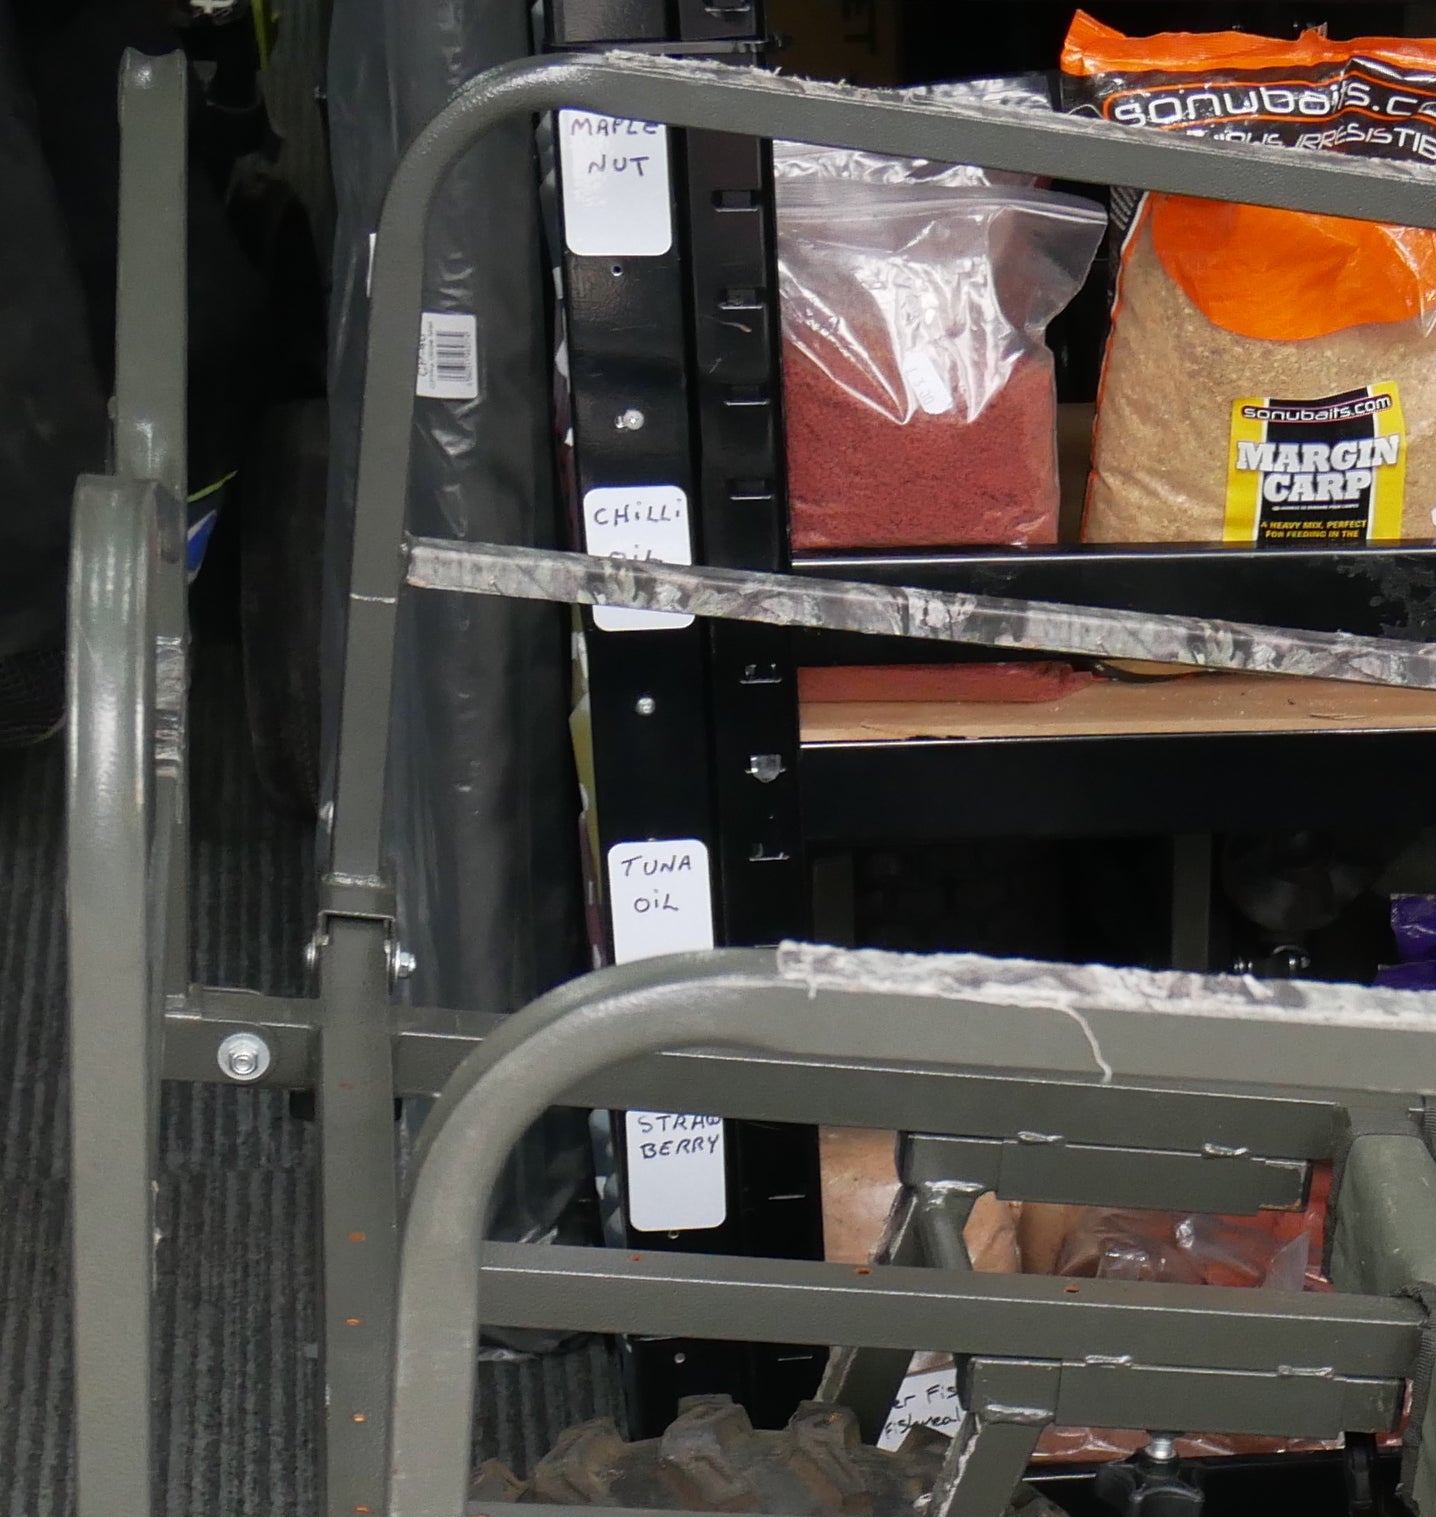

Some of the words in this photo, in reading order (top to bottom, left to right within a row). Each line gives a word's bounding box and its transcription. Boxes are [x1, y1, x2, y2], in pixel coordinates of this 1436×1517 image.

[571, 118, 657, 136] MAPLE
[588, 154, 649, 176] NUT
[1243, 396, 1391, 421] sonubaits.com
[1236, 434, 1400, 473] MARGIN
[1263, 470, 1372, 503] CARP
[1265, 530, 1284, 539] FOR
[1286, 530, 1326, 539] FEEDING
[1328, 530, 1339, 539] IN
[1342, 529, 1359, 539] THE
[1270, 520, 1301, 529] HEAVY
[1327, 519, 1367, 529] PERFECT
[621, 854, 692, 877] TUNA
[638, 1113, 721, 1133] STRAW
[640, 1133, 720, 1160] BERRY
